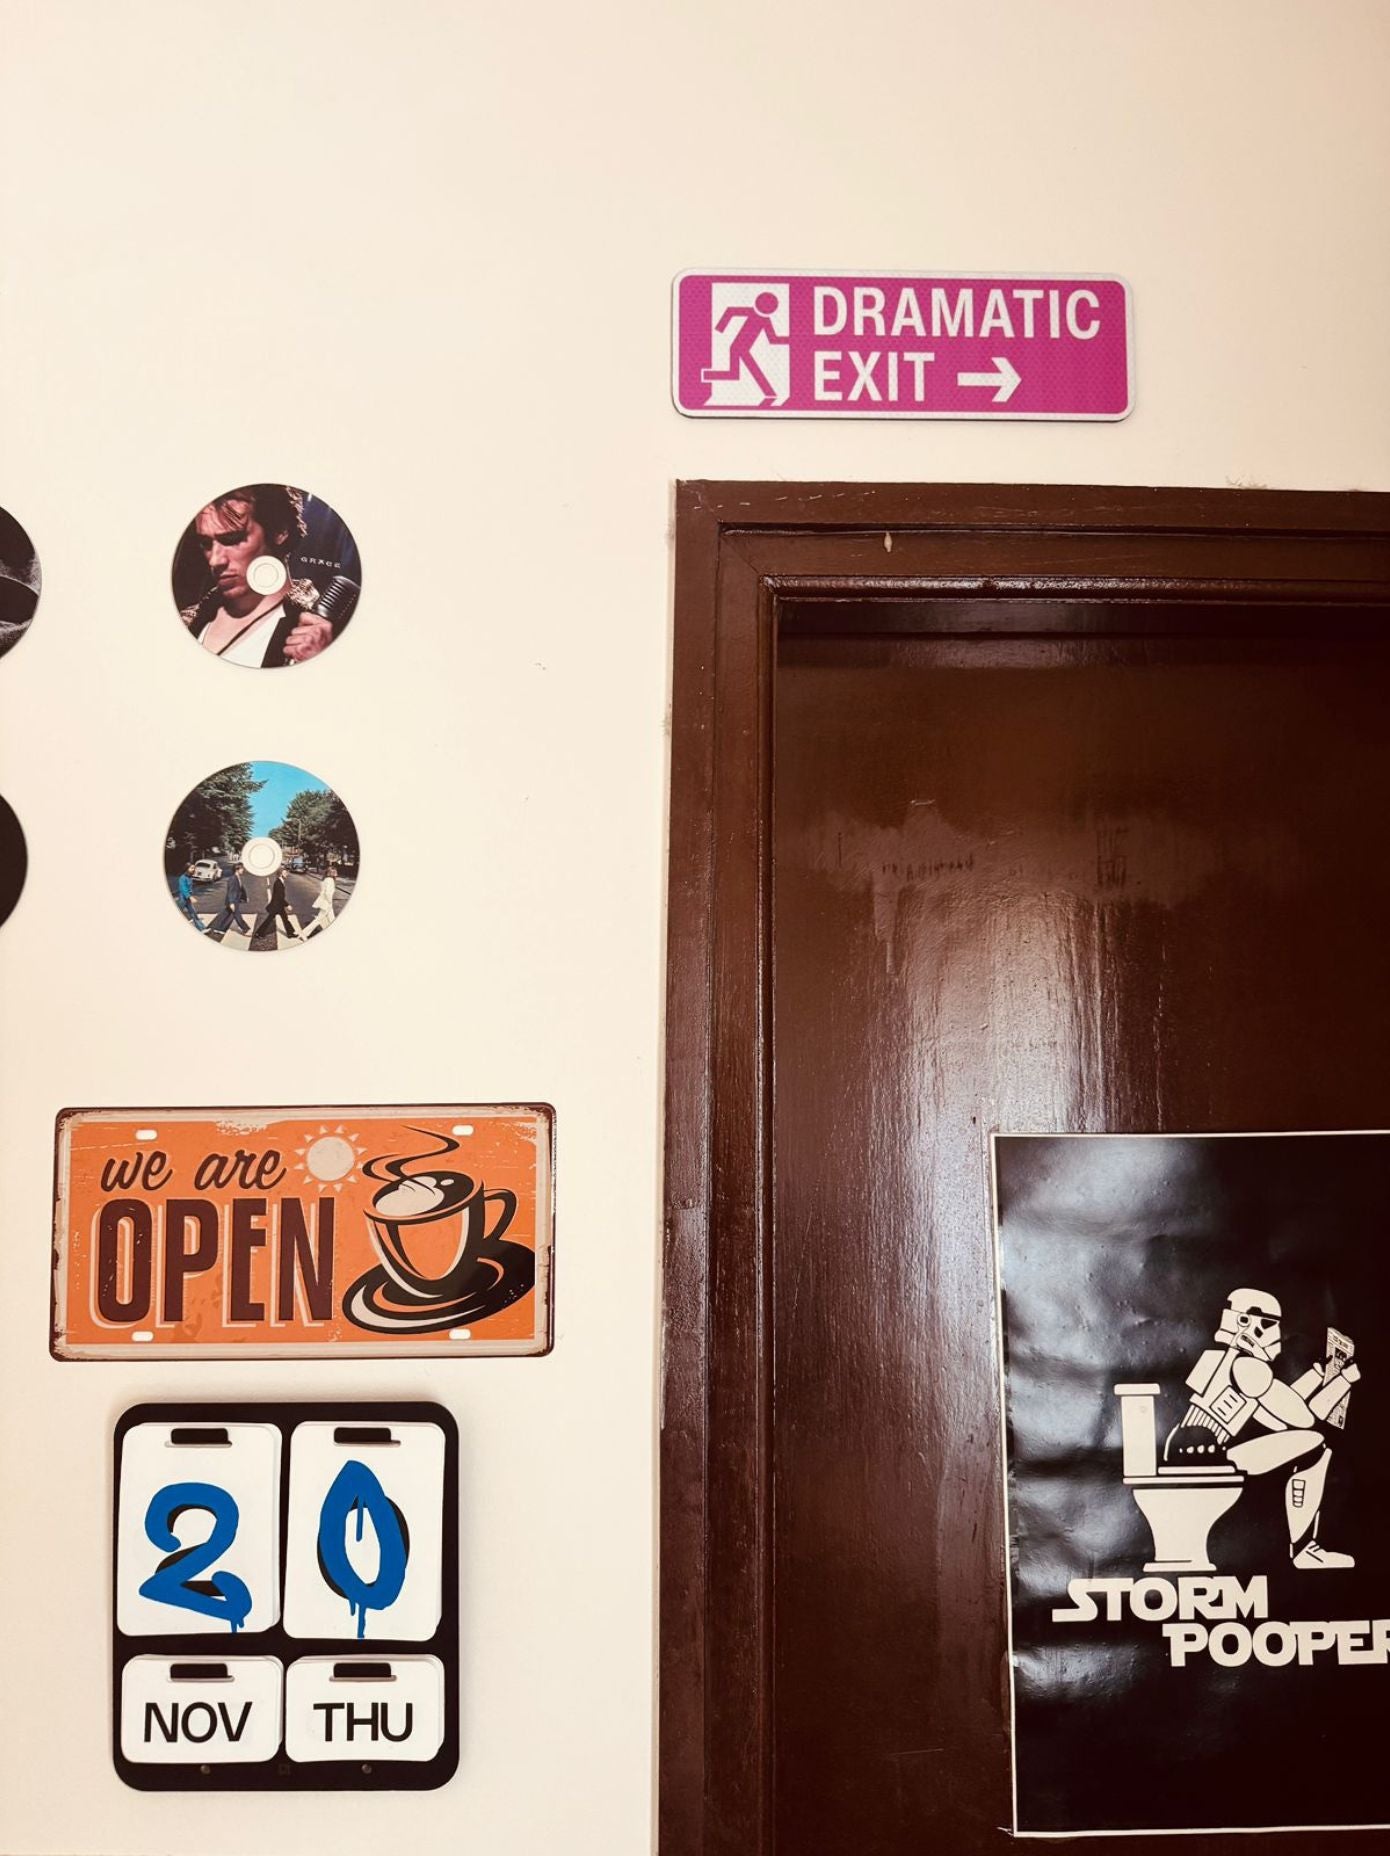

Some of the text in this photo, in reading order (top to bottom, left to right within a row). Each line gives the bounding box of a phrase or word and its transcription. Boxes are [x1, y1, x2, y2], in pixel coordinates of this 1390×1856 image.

[813, 286, 1101, 340] DRAMATIC
[813, 350, 935, 402] EXIT
[300, 556, 341, 568] GRACE
[101, 1149, 287, 1191] we are
[89, 1197, 335, 1328] OPEN
[1052, 1575, 1268, 1622] STORM
[143, 1701, 413, 1743] NOV THU
